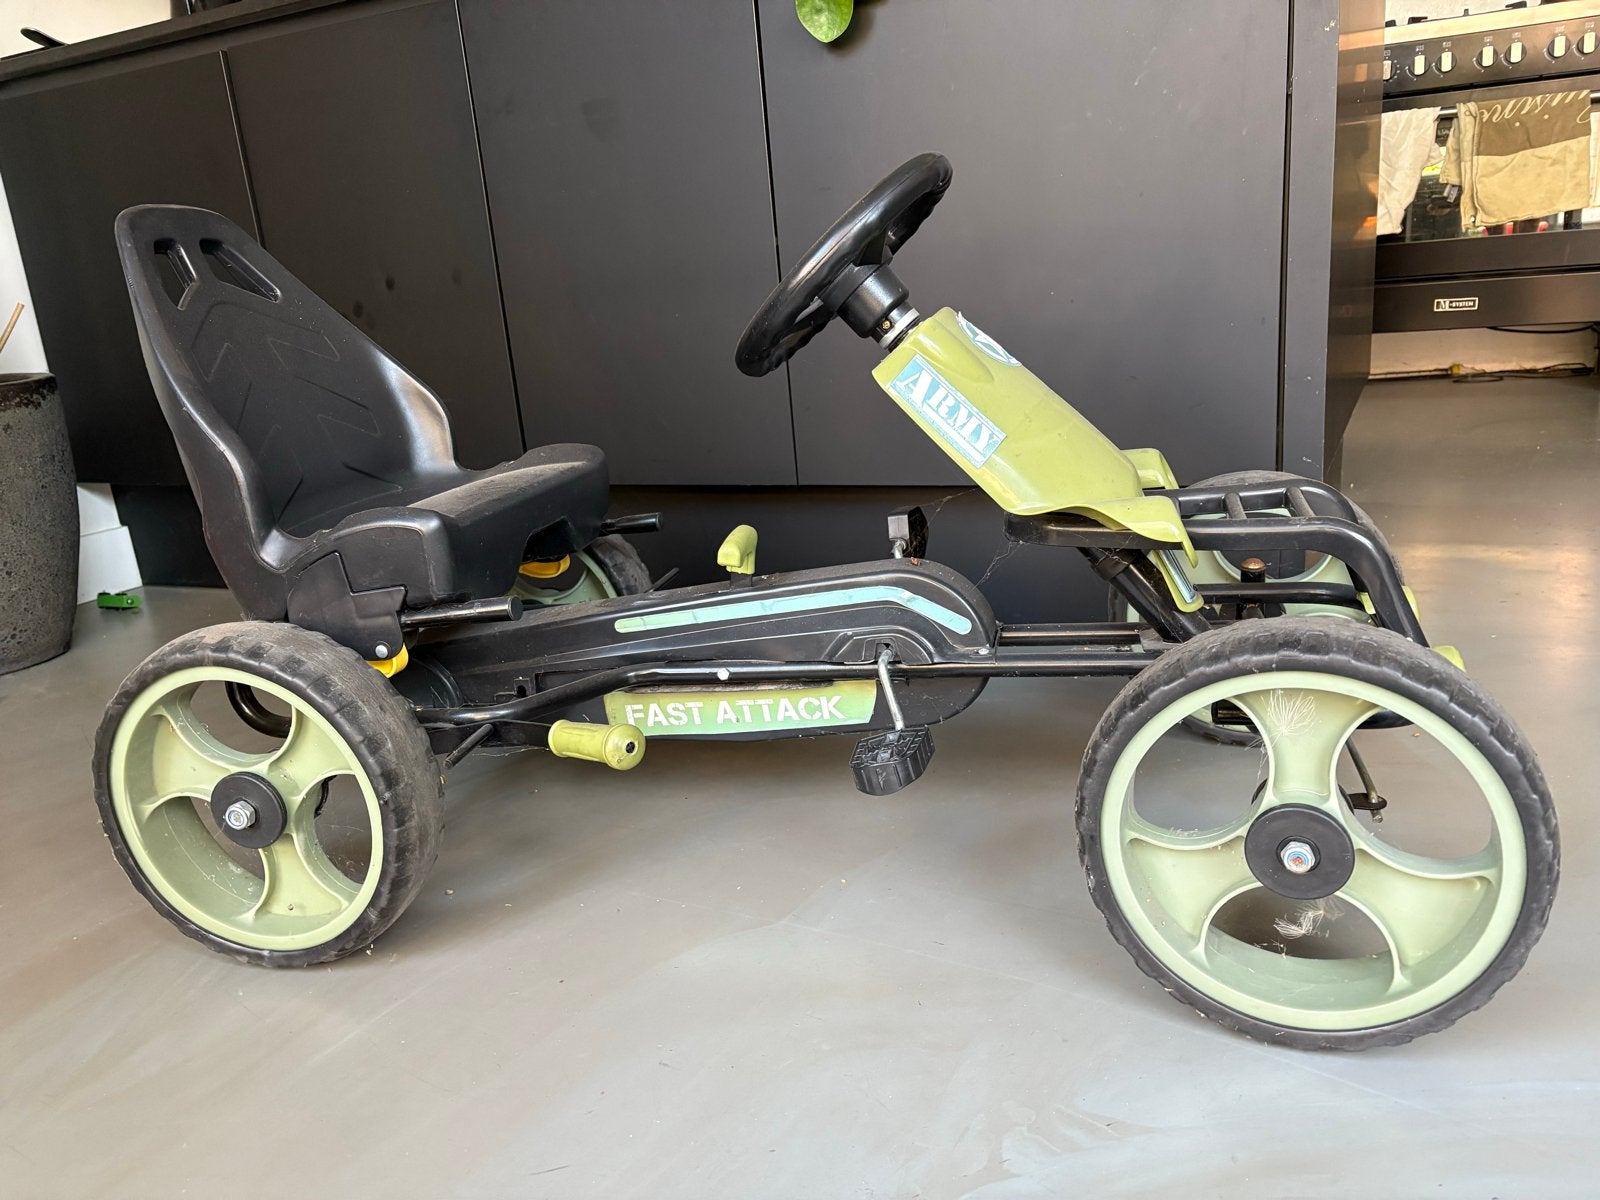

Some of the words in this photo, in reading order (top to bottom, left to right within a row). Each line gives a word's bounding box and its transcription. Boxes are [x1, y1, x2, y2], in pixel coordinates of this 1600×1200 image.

[895, 369, 1001, 452] ARMY
[624, 702, 704, 727] FAST
[716, 695, 847, 725] ATTACK
